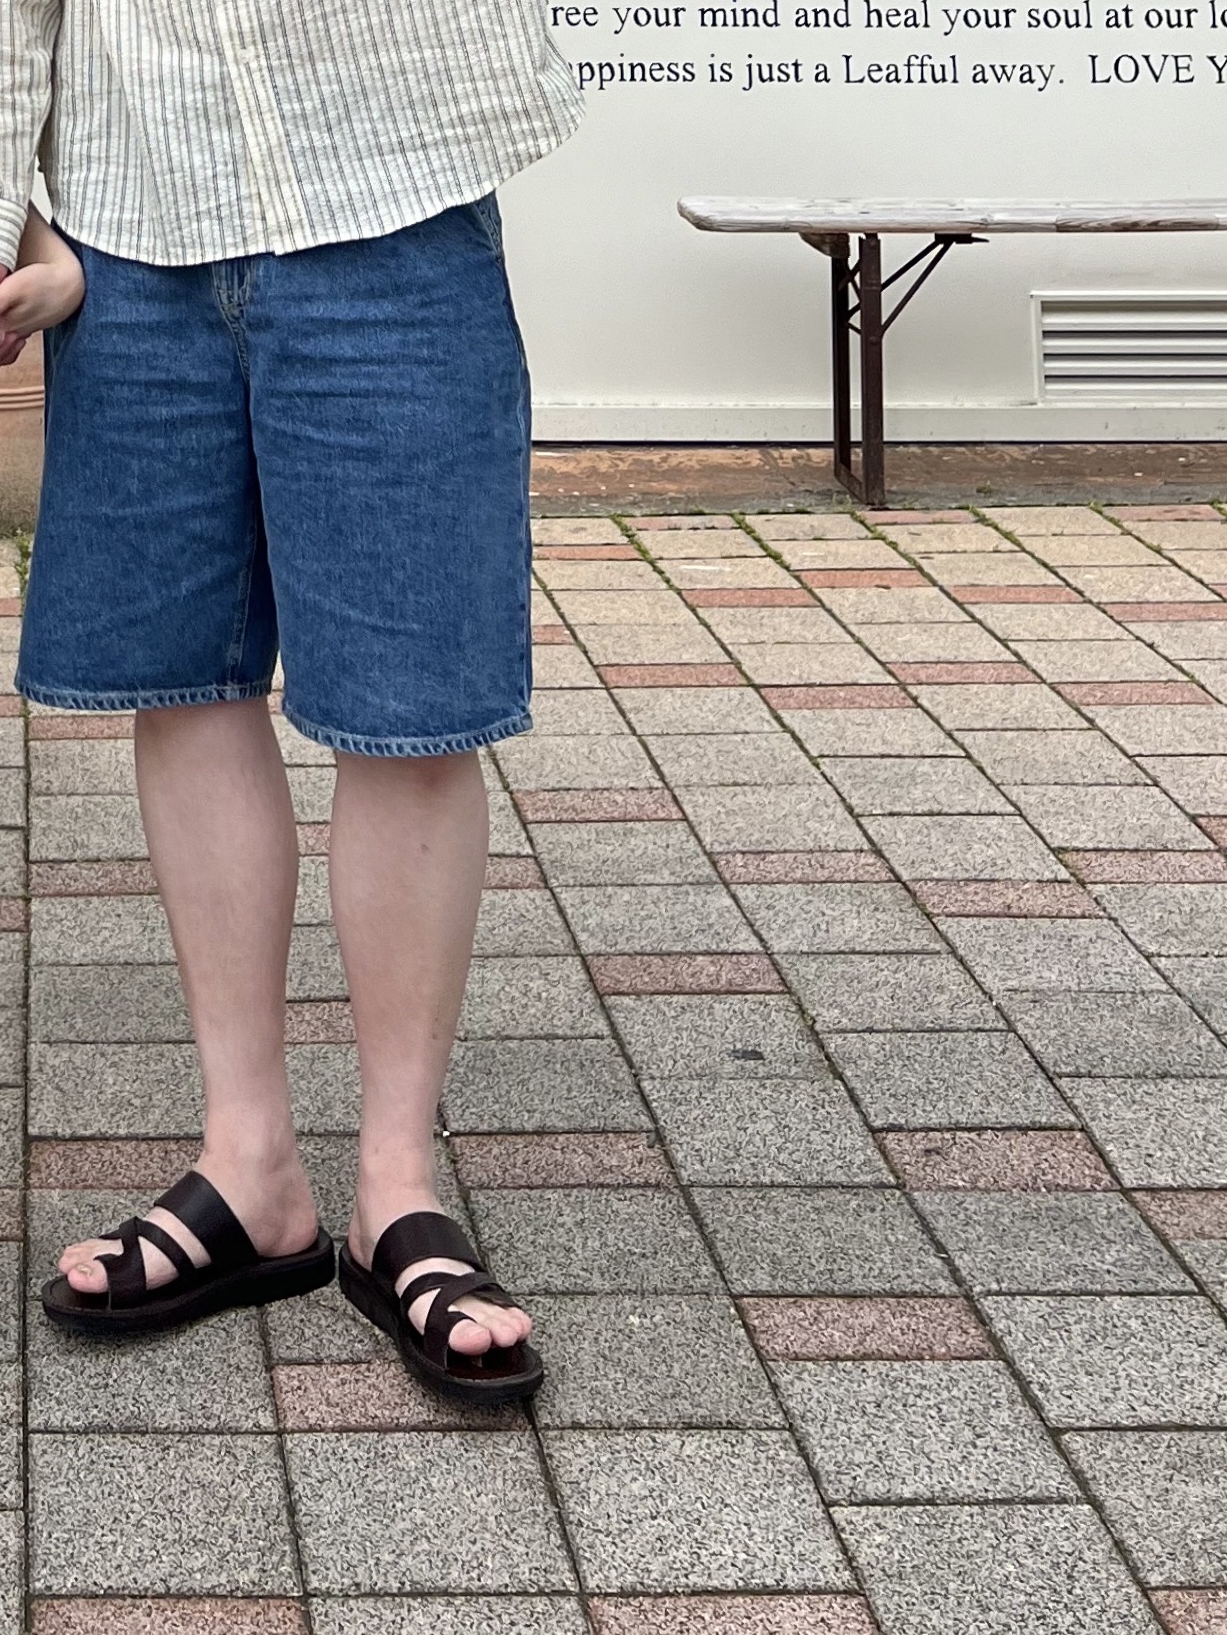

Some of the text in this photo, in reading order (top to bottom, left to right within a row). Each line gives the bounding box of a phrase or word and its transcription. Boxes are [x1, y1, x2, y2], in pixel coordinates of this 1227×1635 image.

[546, 0, 599, 28] ree
[611, 6, 687, 35] your
[794, 0, 852, 28] and
[941, 8, 1017, 37] your
[1027, 0, 1093, 29] soul
[1105, 4, 1134, 29] at
[1144, 8, 1199, 29] our
[568, 52, 696, 91] ppiness
[708, 53, 733, 83] is
[741, 53, 804, 92] just
[814, 63, 831, 84] a
[841, 54, 959, 84] Leafful
[972, 63, 1064, 93] away.
[1088, 54, 1195, 84] LOVE
